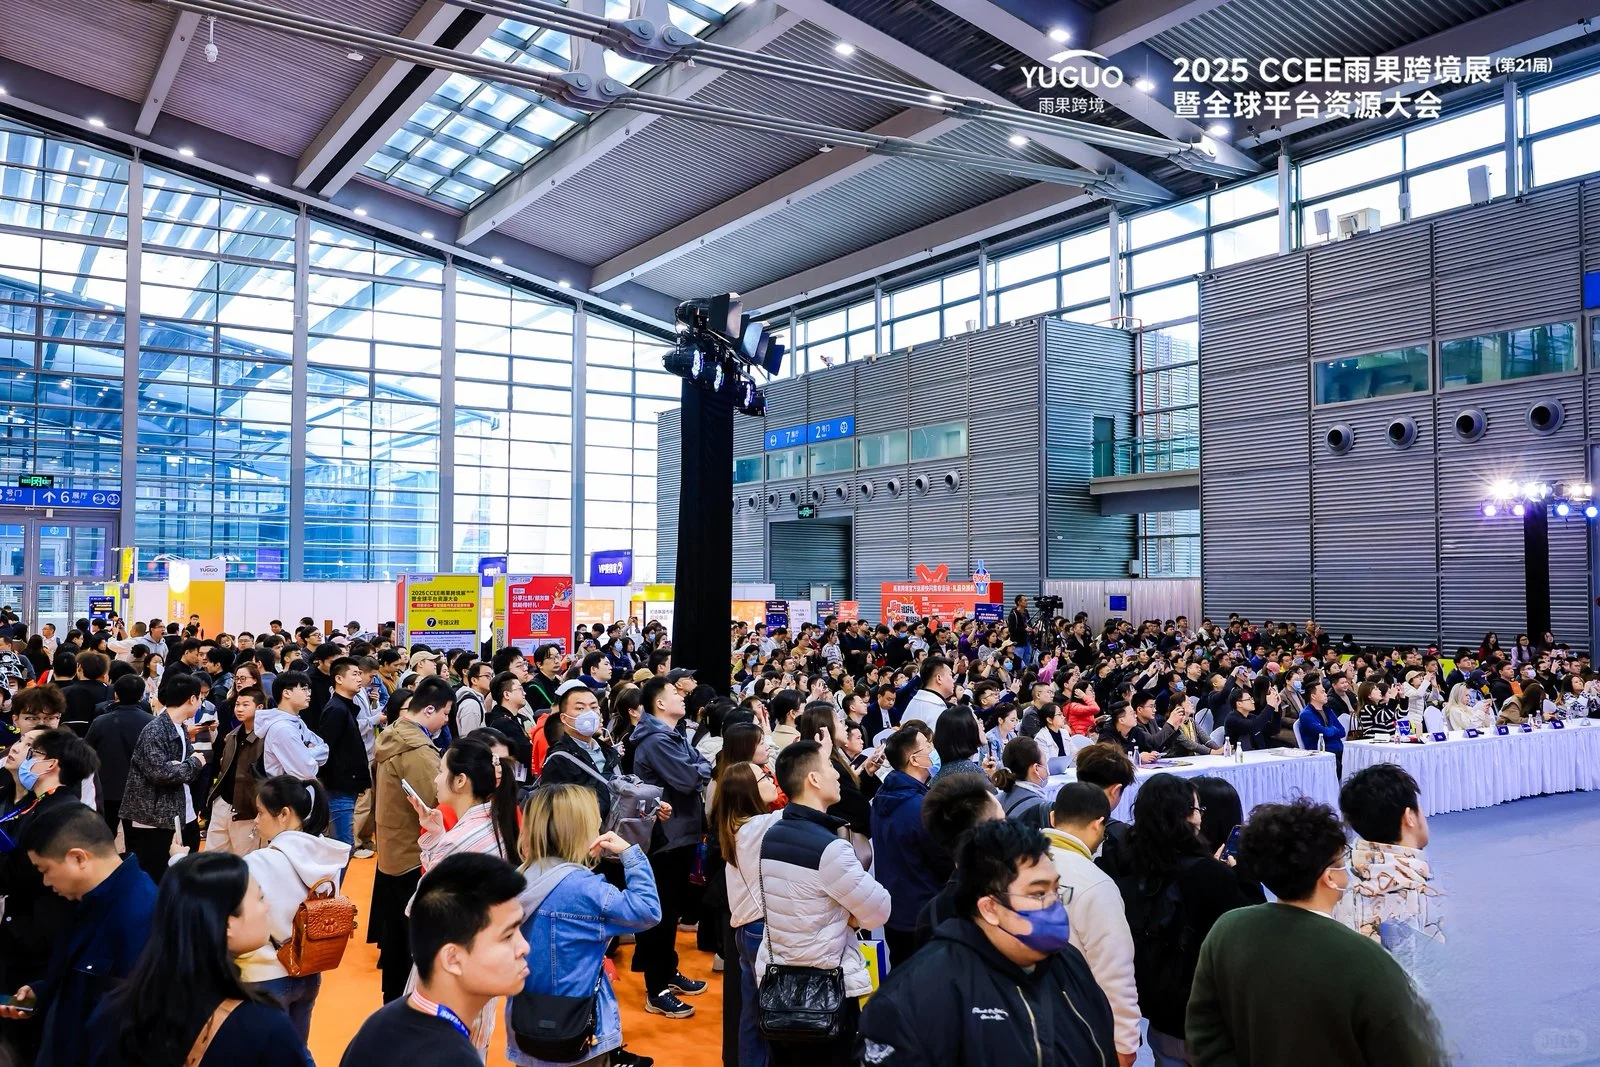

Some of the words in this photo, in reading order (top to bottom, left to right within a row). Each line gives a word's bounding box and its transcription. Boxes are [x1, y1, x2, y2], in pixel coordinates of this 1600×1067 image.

[815, 425, 821, 439] 2
[6, 489, 22, 497] 号门
[60, 491, 70, 504] 6
[72, 491, 88, 499] 展厅
